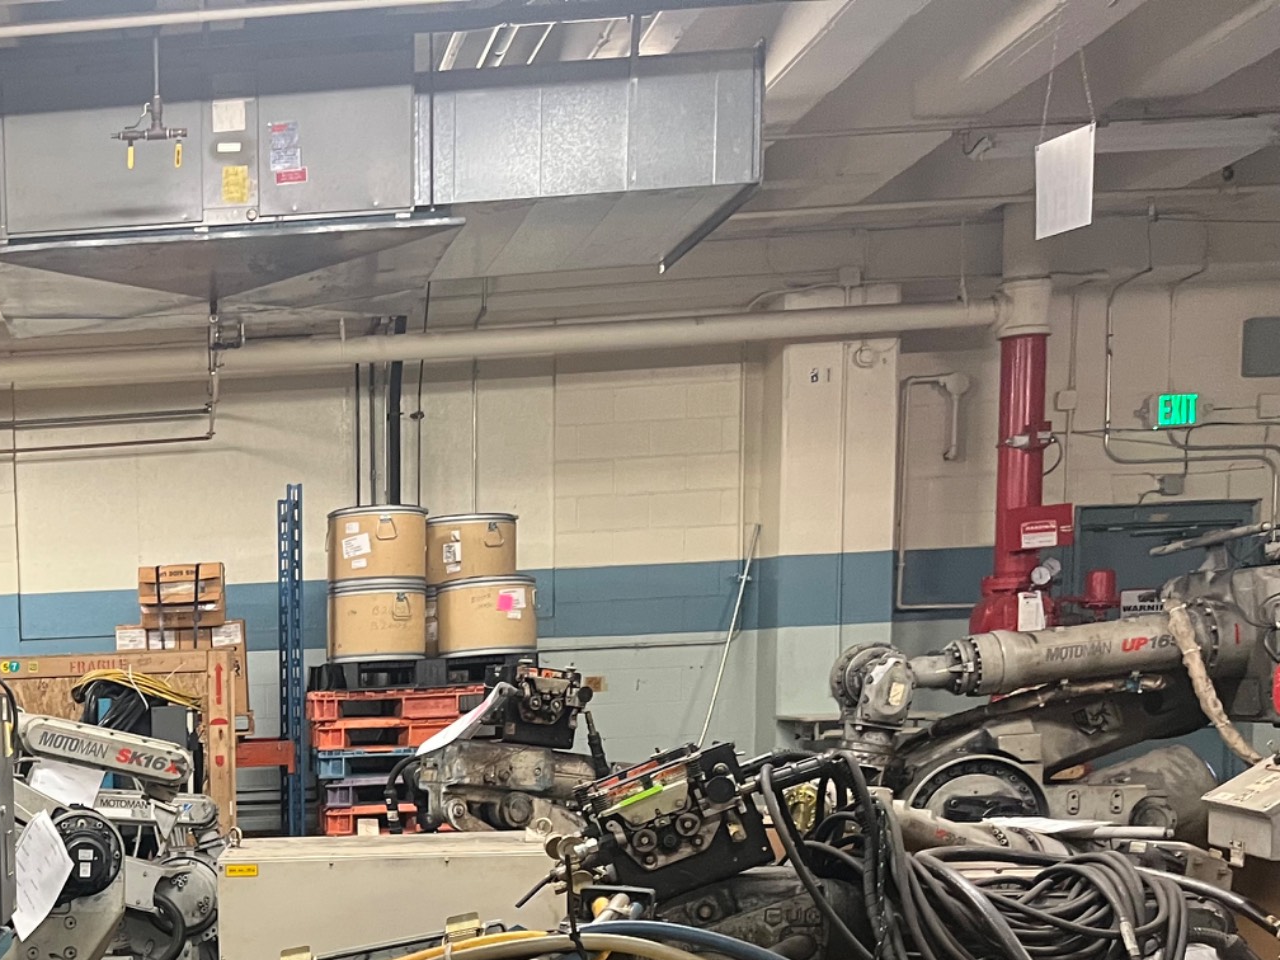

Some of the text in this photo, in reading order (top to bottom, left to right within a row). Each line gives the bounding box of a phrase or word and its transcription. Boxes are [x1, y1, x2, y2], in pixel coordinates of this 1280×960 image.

[1158, 393, 1199, 425] EXIT
[1046, 640, 1112, 662] MOTOMAN
[70, 659, 127, 673] FRAGILE
[38, 731, 110, 759] MOTOMAN
[100, 799, 148, 809] MOTOMAN
